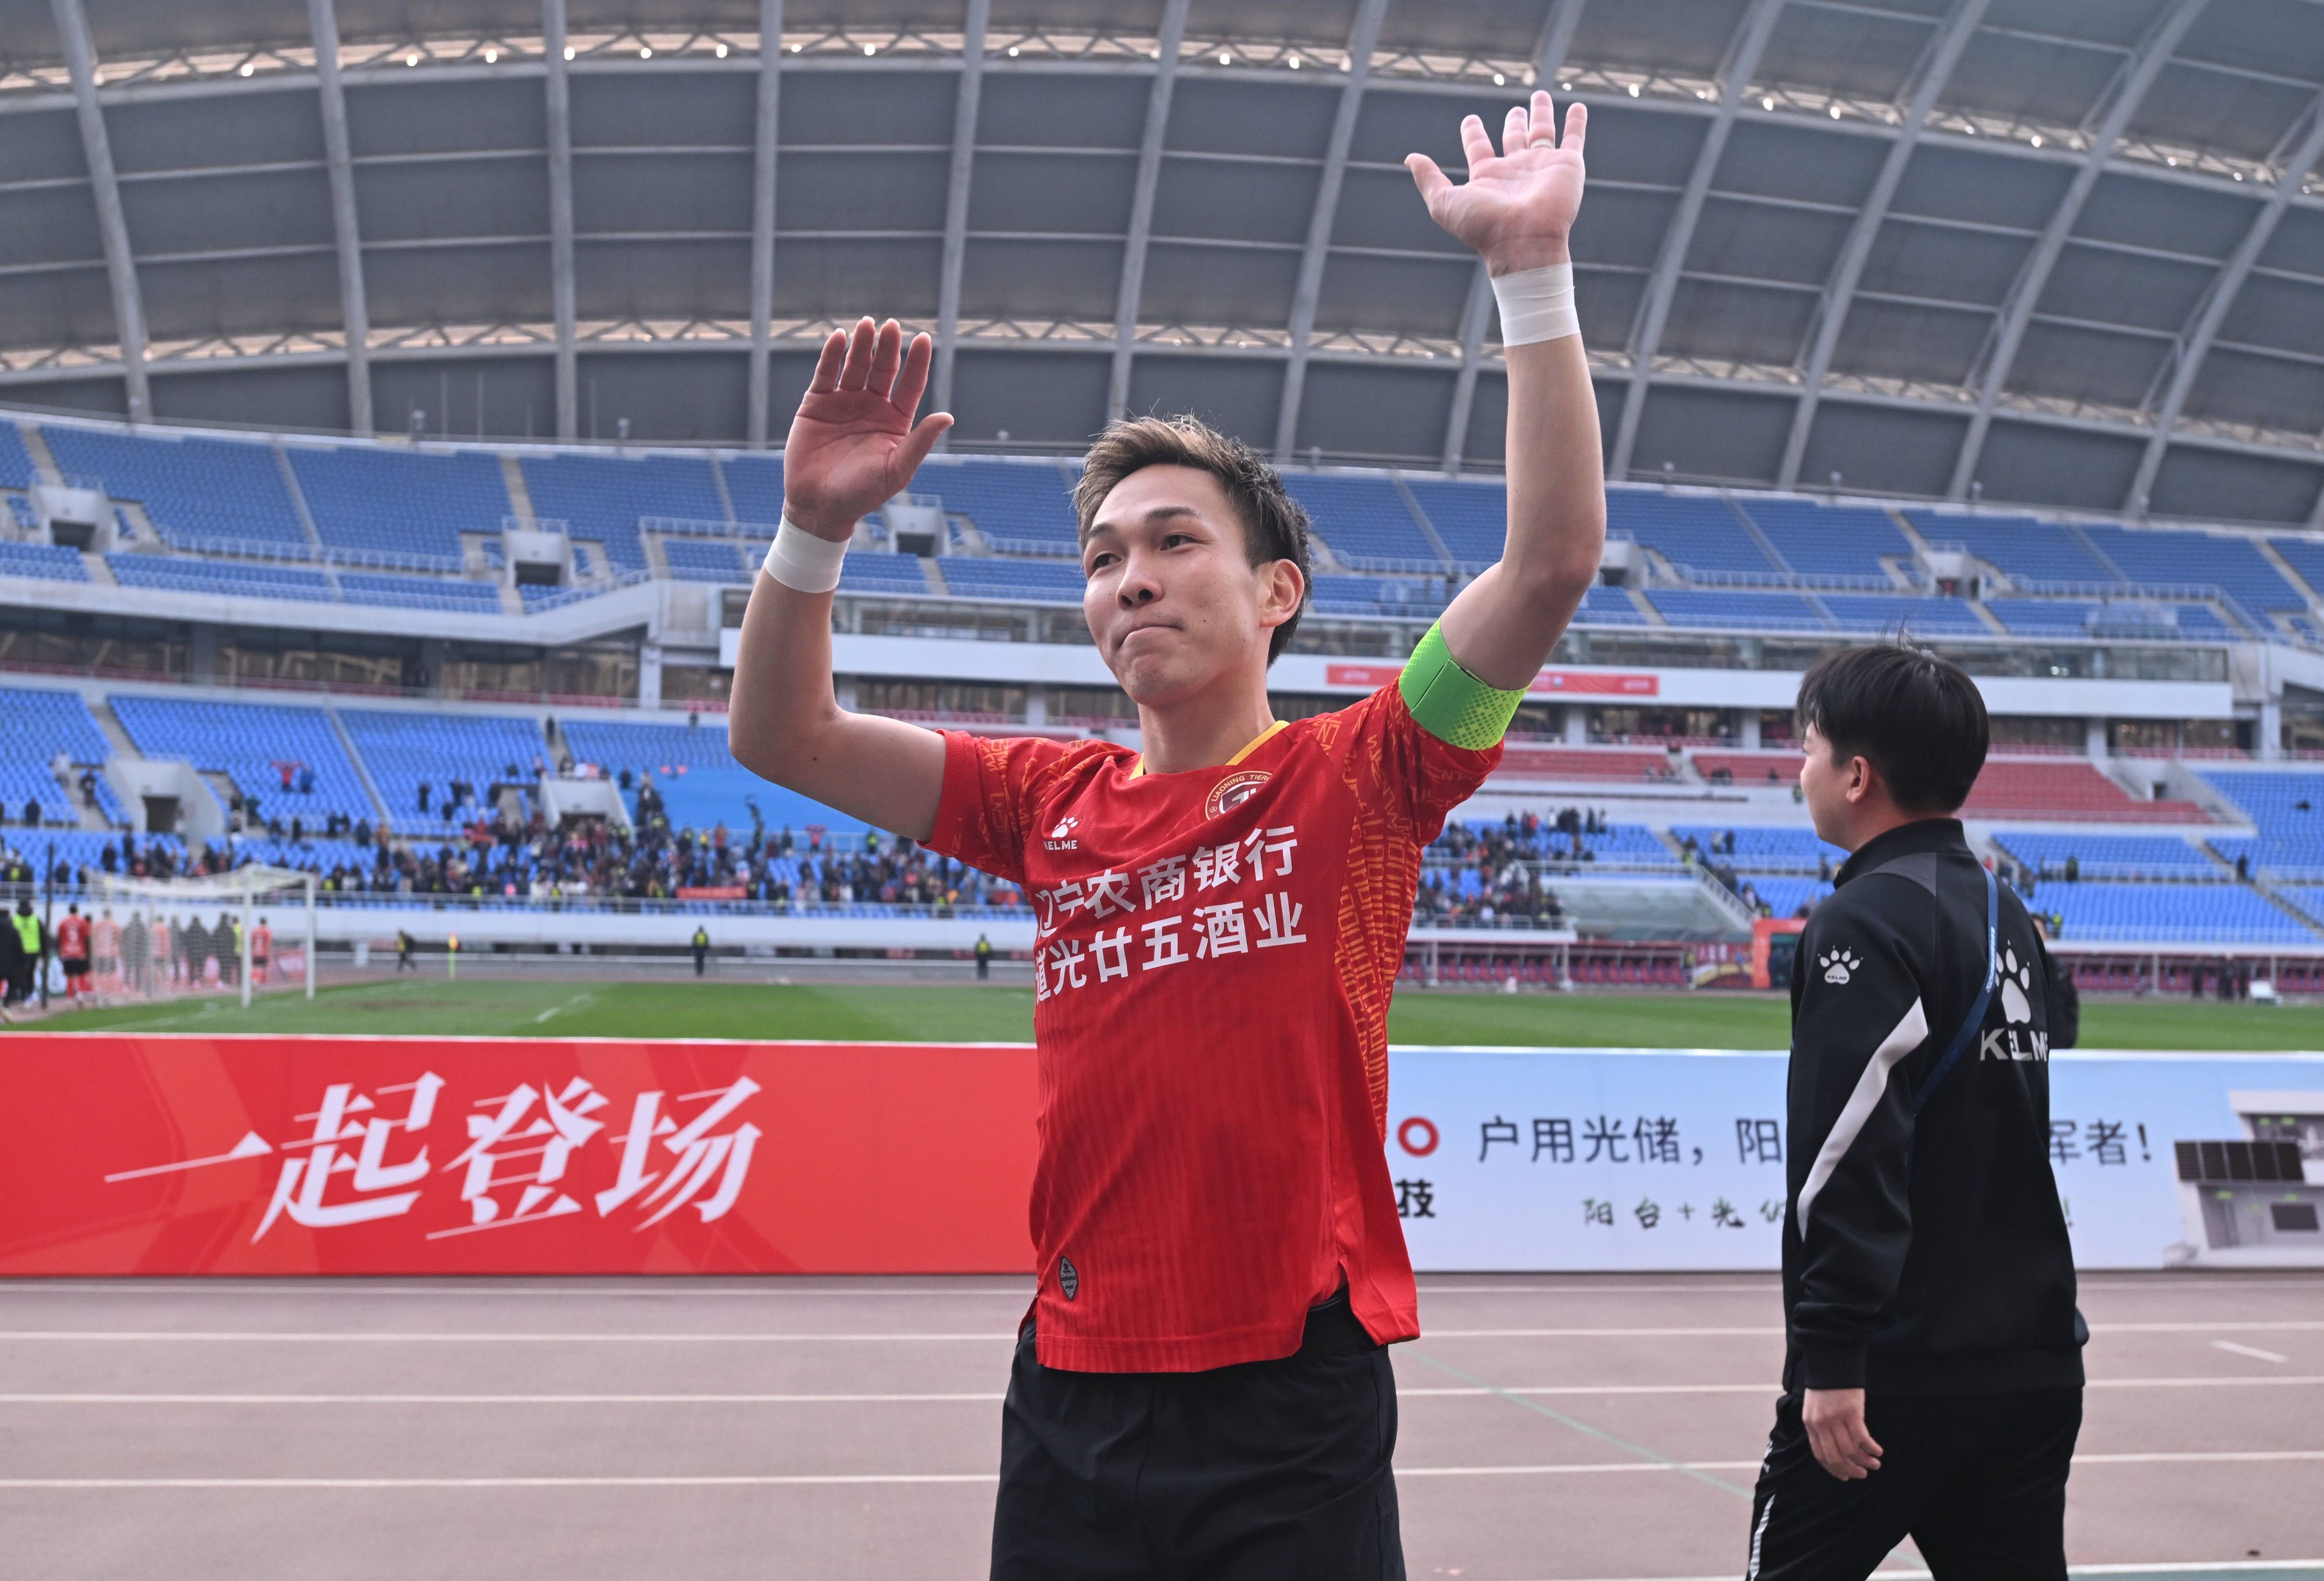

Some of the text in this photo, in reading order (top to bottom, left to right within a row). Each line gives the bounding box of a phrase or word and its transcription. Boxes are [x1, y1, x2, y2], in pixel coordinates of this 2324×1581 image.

[1043, 840, 1077, 850] KELME
[1211, 775, 1245, 802] LIAONING
[1035, 825, 1298, 939] 辽宁农商银行
[1036, 892, 1307, 1005] 道光廿五酒业
[104, 1071, 763, 1245] 一起登场
